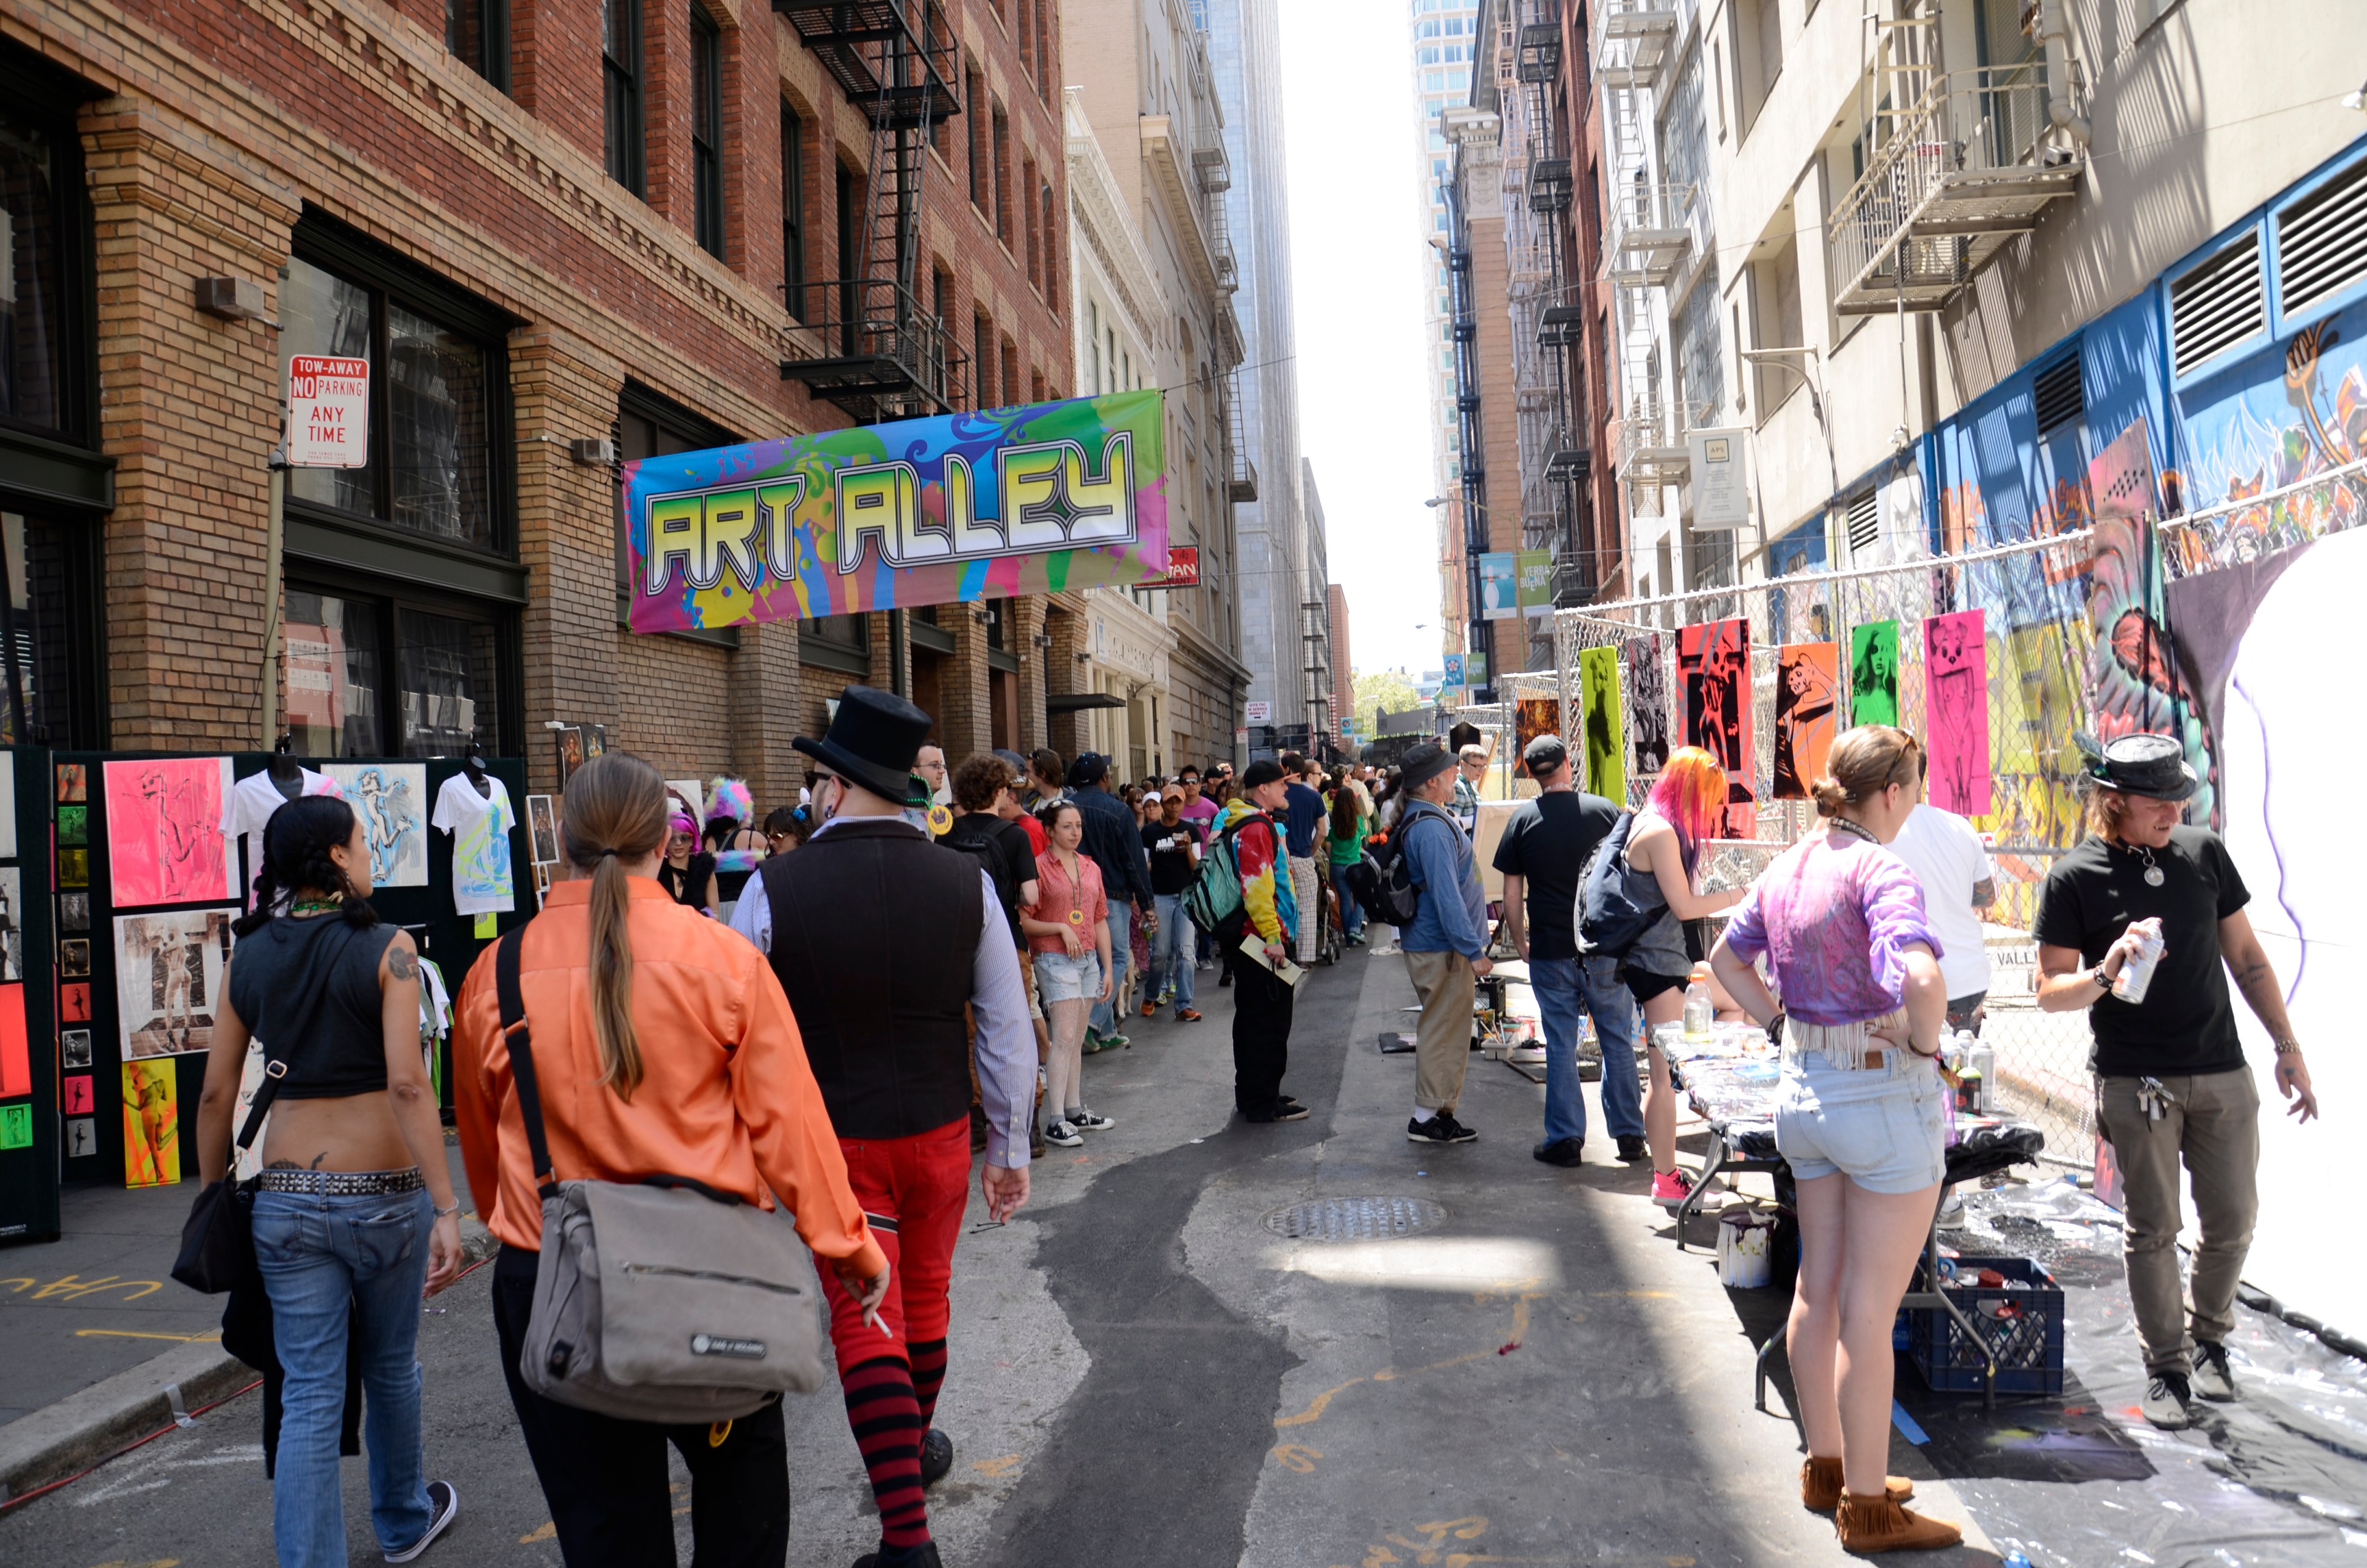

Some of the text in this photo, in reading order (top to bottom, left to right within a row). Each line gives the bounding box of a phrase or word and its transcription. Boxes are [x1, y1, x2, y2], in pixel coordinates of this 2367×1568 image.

[298, 359, 362, 376] TOW-AWAY
[293, 376, 363, 398] NO PARKING
[311, 406, 345, 422] ANY
[308, 425, 346, 443] TIME
[645, 430, 1138, 596] ART ALLEY
[1524, 564, 1550, 578] YERBA
[1520, 576, 1546, 592] BUENA
